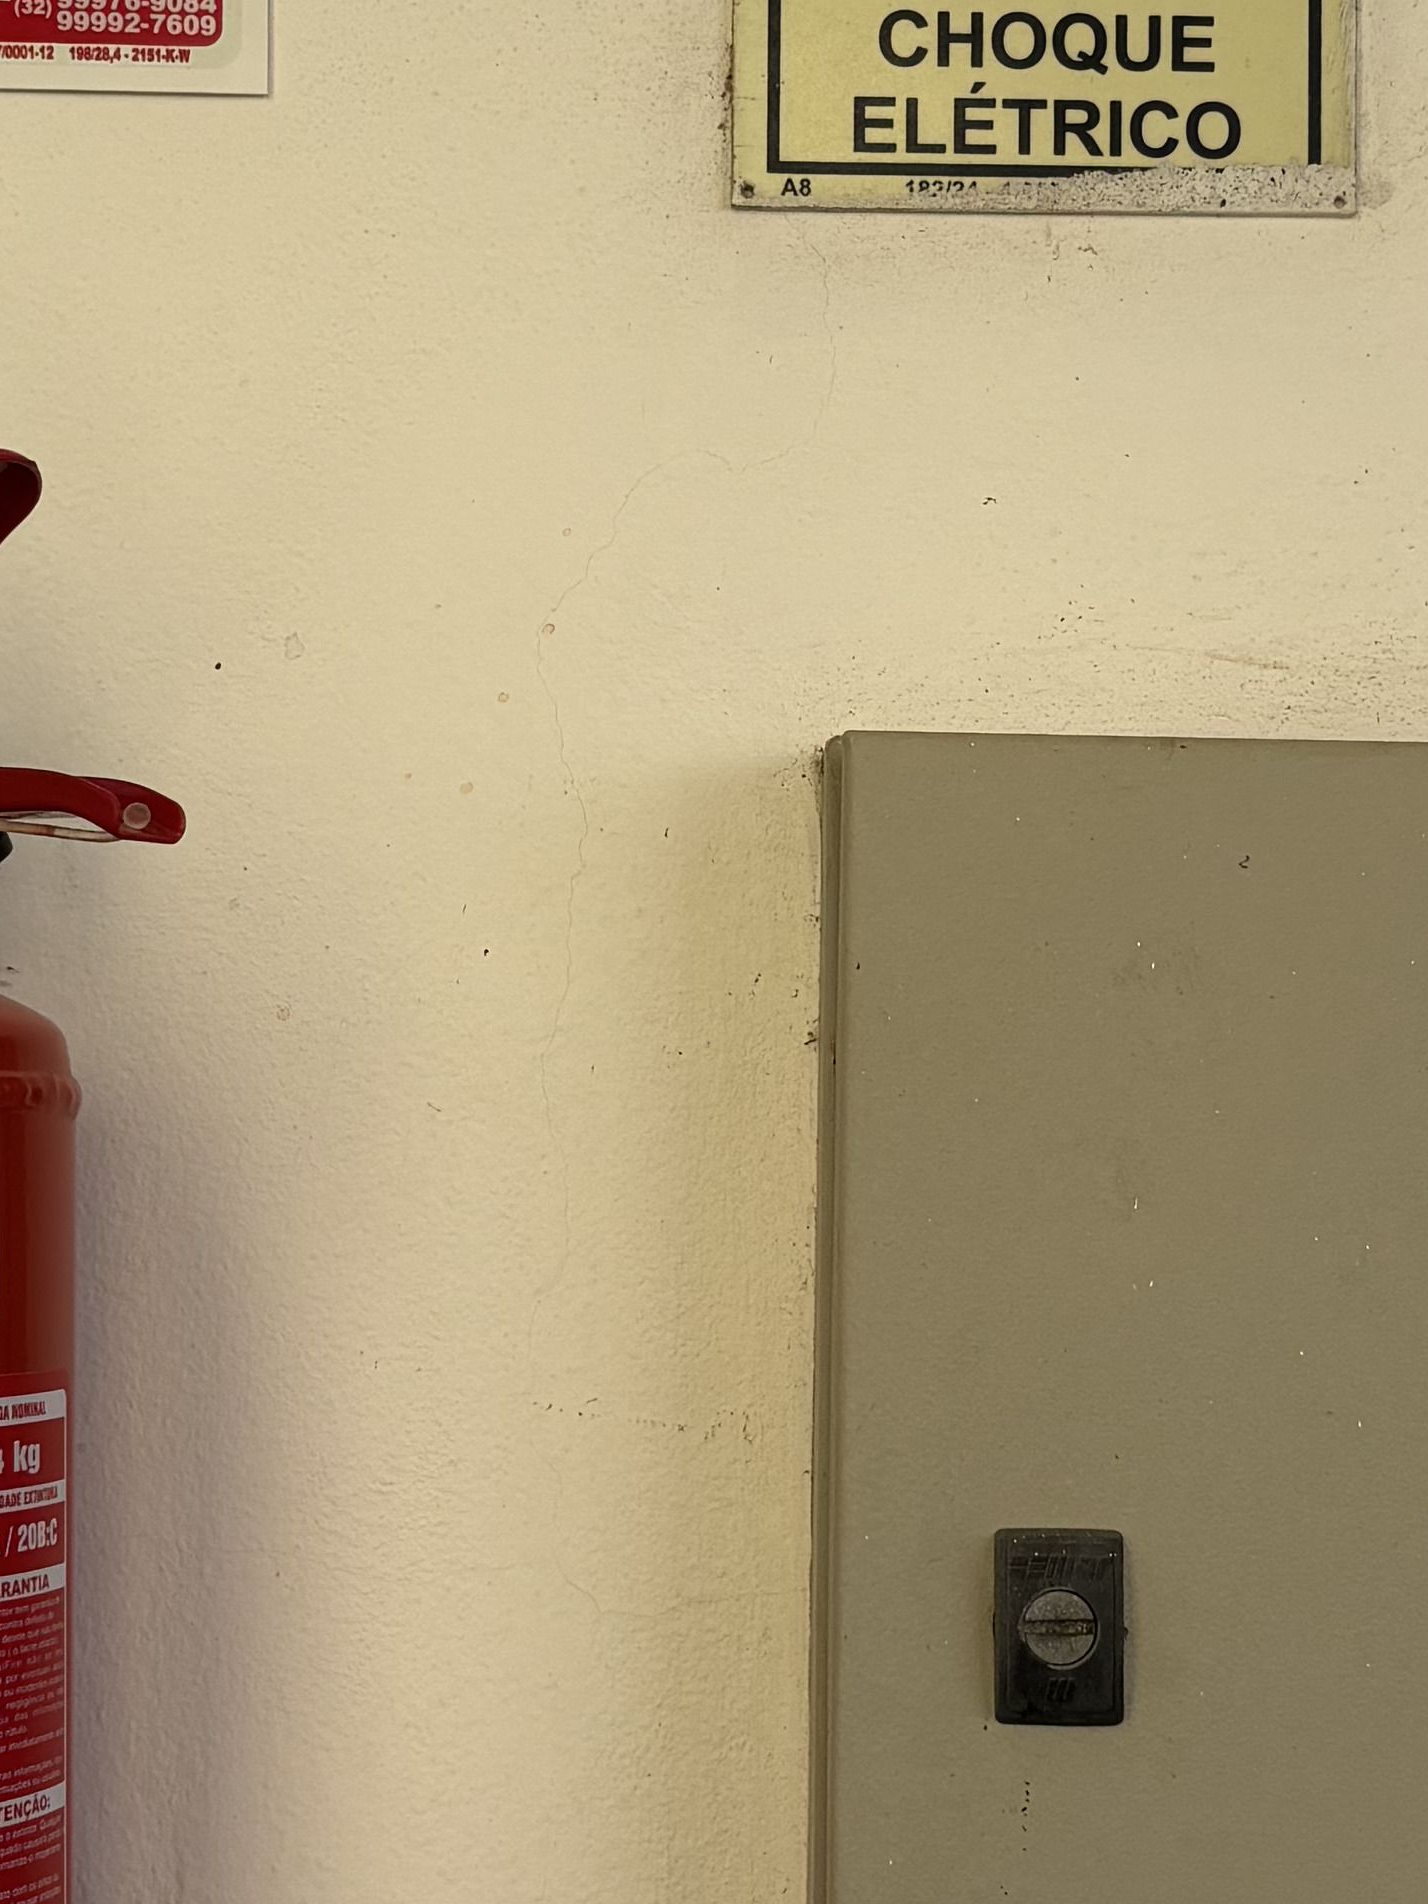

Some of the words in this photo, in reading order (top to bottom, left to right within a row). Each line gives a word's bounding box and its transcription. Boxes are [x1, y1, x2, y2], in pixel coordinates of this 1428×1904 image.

[56, 10, 216, 36] 99992-7609
[877, 10, 1216, 76] CHOQUE
[852, 81, 1242, 161] ELÉTRICO
[781, 178, 812, 196] A8
[13, 1440, 41, 1474] kg
[17, 1517, 58, 1553] 20B:C
